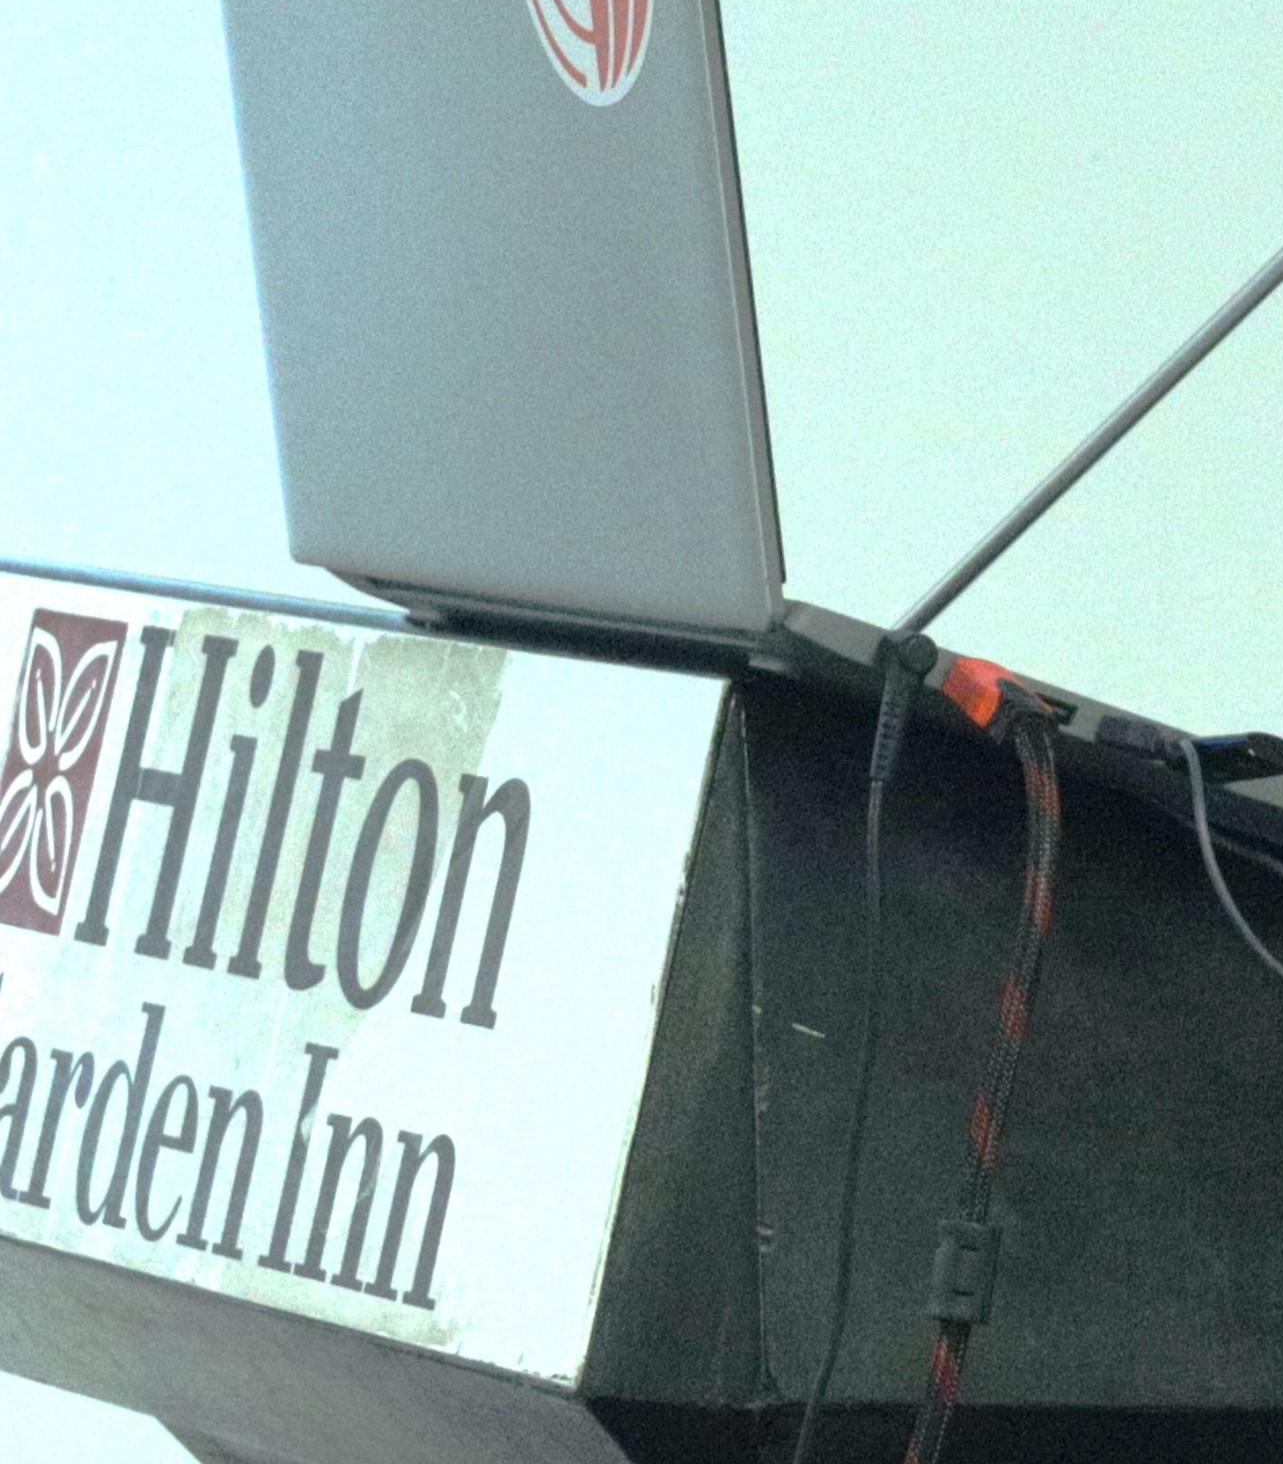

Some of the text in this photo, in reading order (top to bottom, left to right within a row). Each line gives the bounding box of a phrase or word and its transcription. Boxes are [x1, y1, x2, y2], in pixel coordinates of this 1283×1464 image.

[74, 626, 531, 1030] Hilton
[0, 1002, 456, 1311] arden Inn
